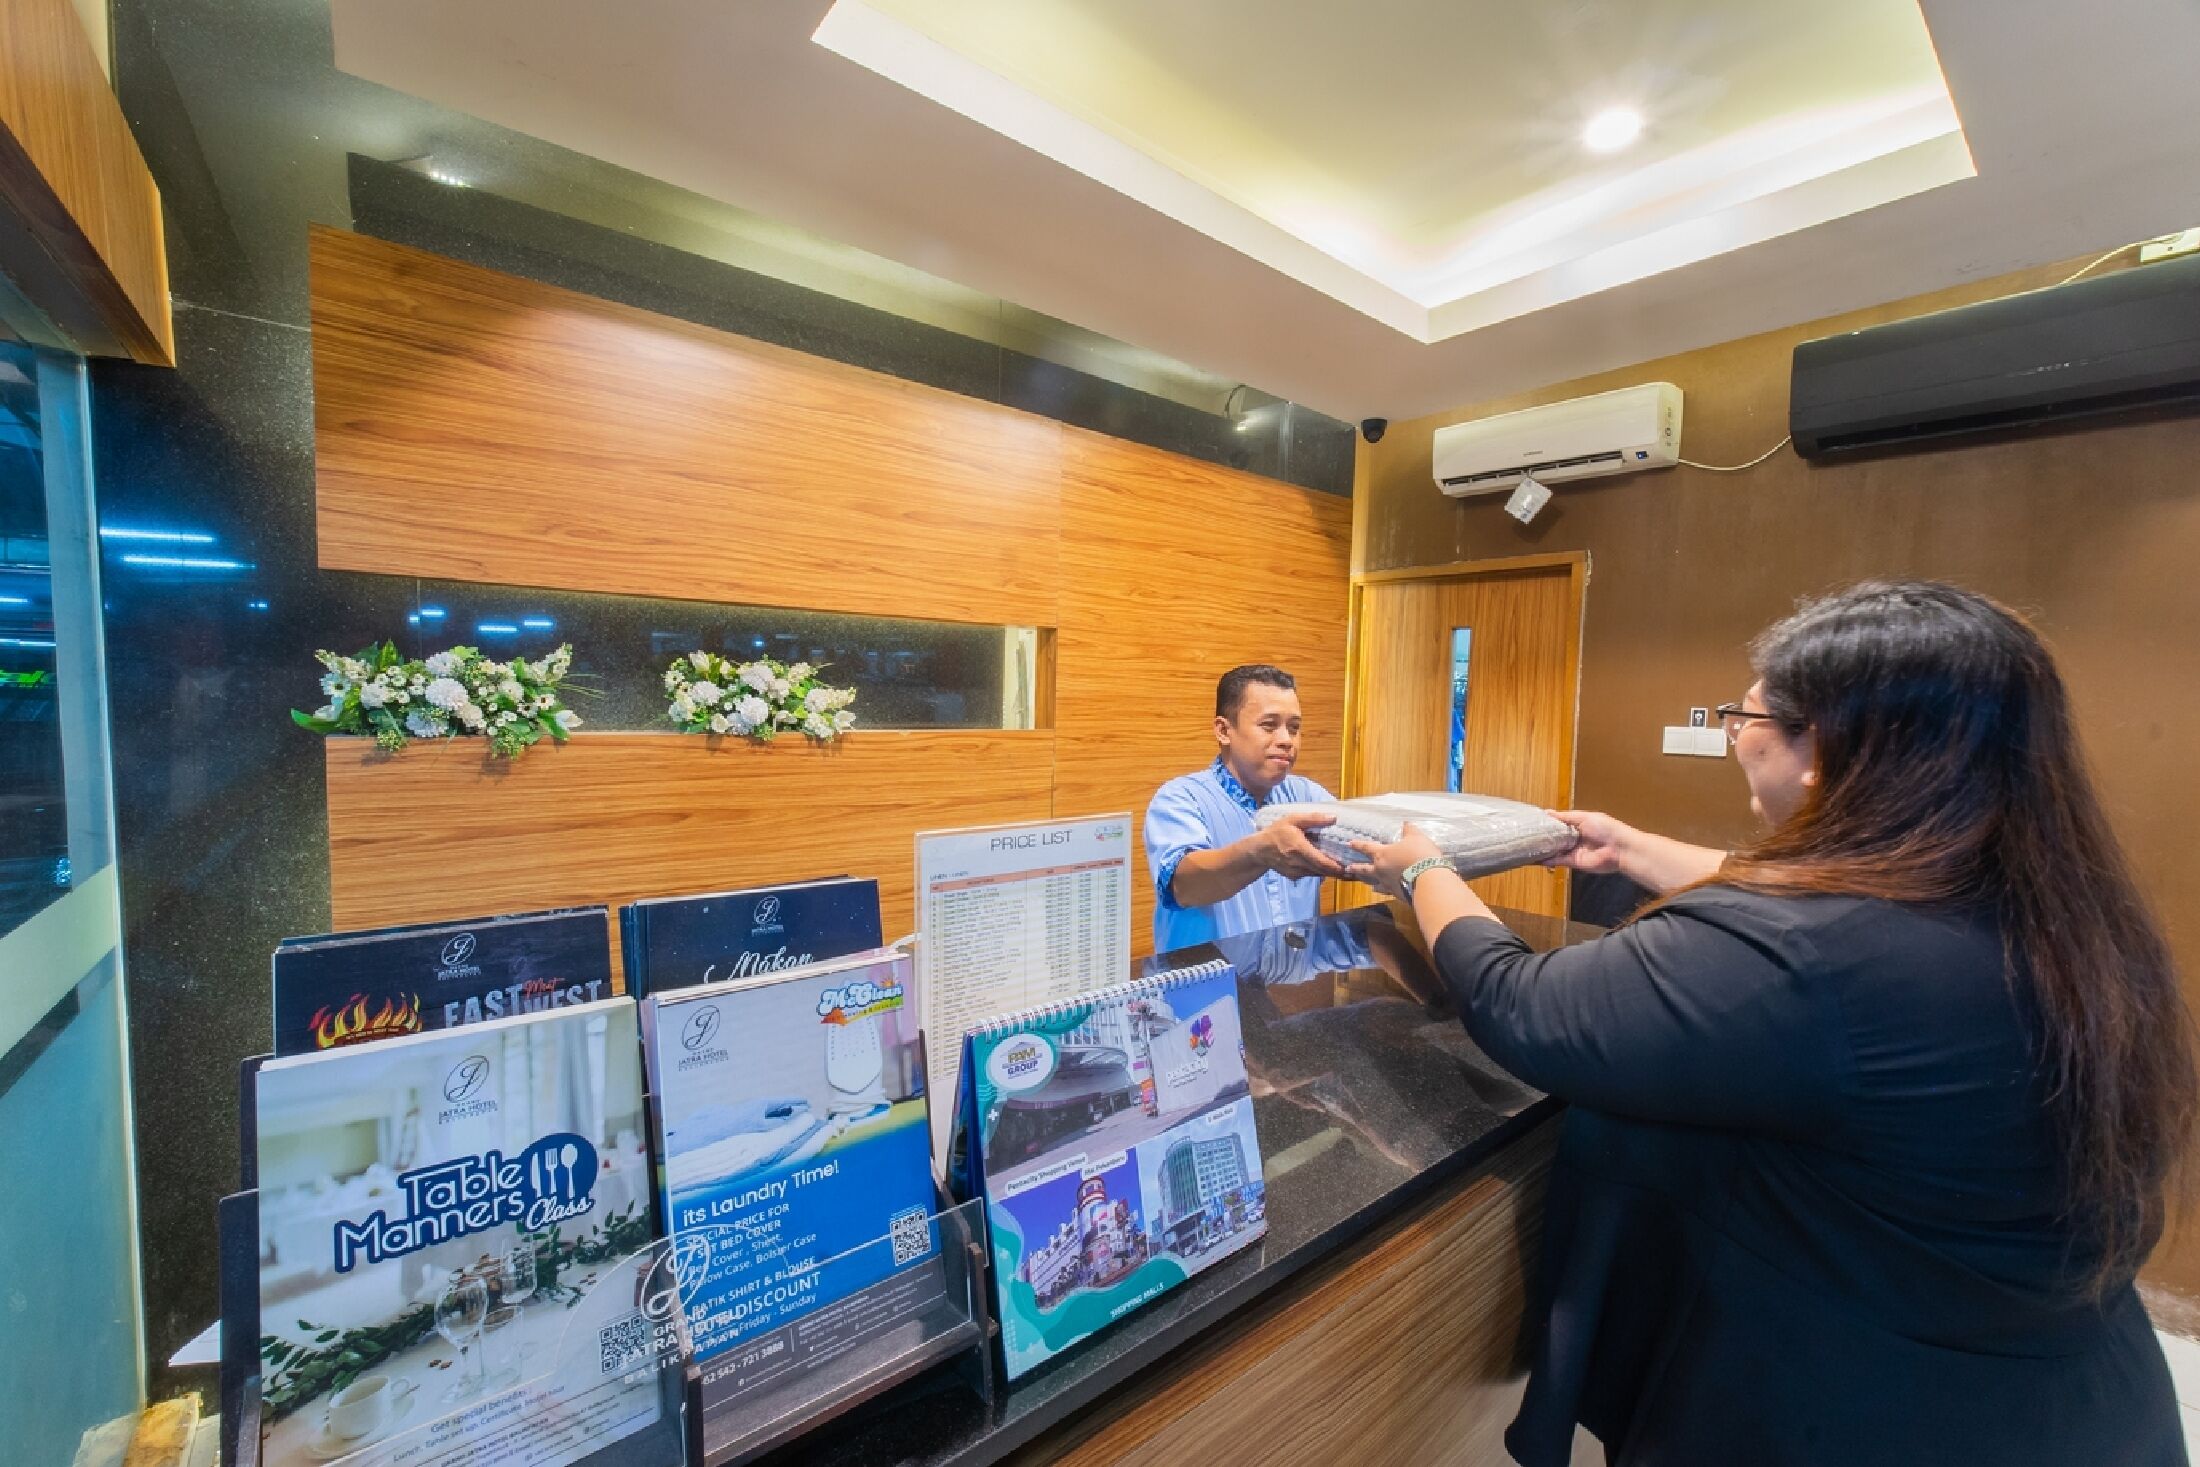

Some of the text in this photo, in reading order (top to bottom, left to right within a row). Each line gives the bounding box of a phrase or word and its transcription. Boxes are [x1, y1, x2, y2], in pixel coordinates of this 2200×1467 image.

[991, 829, 1072, 851] PRICE LIST
[444, 984, 524, 1028] EAST
[1007, 1060, 1038, 1075] GROUP
[403, 1154, 523, 1216] Table
[683, 1160, 840, 1227] its Laundry Time!
[341, 1190, 526, 1268] Manners
[526, 1196, 591, 1231] Class
[735, 1212, 765, 1229] PRICE
[768, 1203, 790, 1217] FOR
[721, 1233, 744, 1251] BED
[746, 1219, 781, 1241] COVER
[793, 1233, 817, 1248] Case
[712, 1249, 744, 1267] Cover
[728, 1279, 760, 1301] SHIRT
[764, 1275, 773, 1286] &
[735, 1271, 821, 1319] DISCOUNT
[739, 1294, 816, 1331] Friday Sunday
